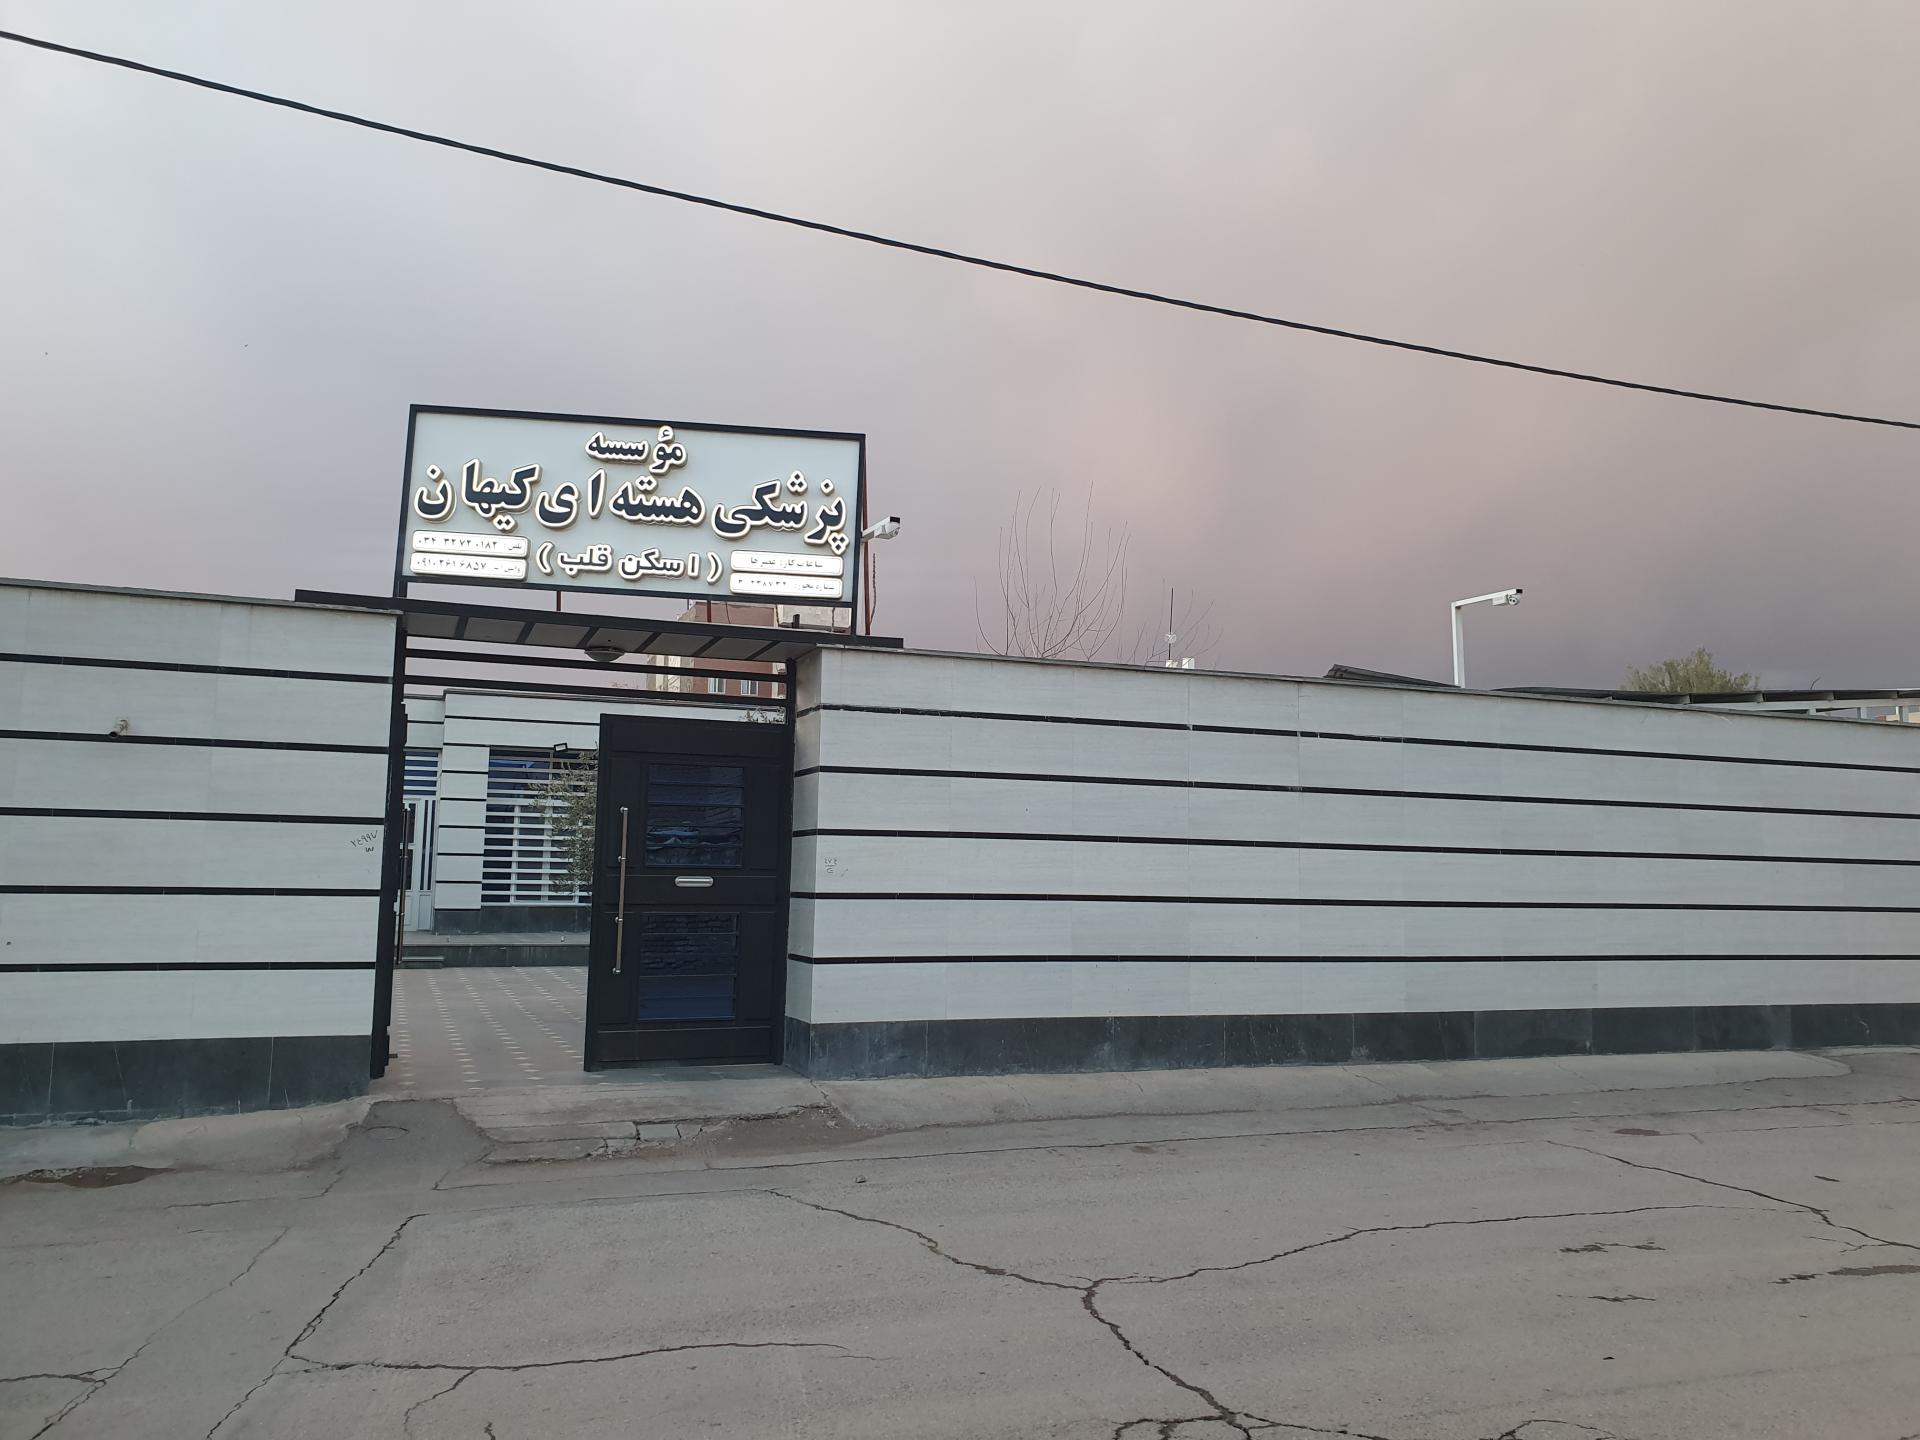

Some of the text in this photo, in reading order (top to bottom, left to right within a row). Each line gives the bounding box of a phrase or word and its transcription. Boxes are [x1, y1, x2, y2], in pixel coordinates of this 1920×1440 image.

[585, 426, 688, 476] مؤسسه
[414, 458, 849, 555] پزشکی هسته ای کیهان
